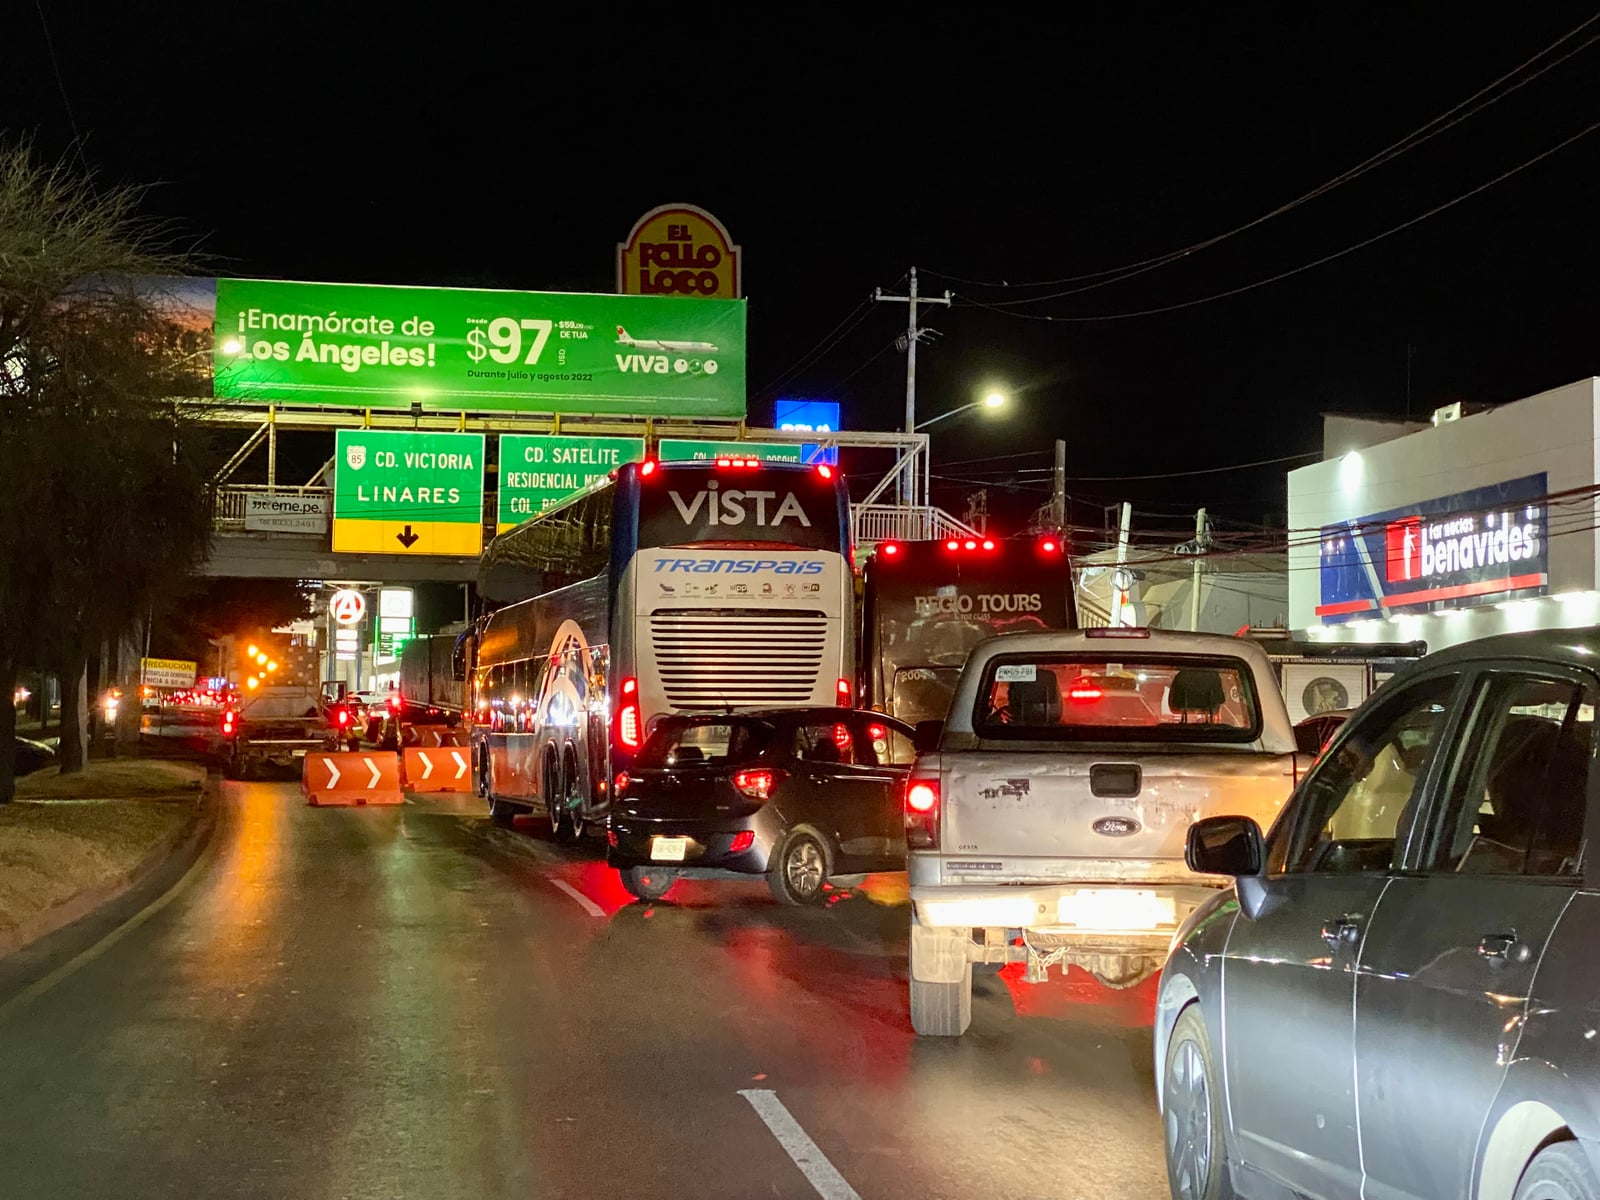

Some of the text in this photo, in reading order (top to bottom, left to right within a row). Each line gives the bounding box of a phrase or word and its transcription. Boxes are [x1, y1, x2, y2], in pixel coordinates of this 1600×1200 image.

[668, 224, 692, 241] EL
[639, 243, 721, 269] POLLO
[640, 270, 719, 295] LOCO
[238, 309, 435, 337] ¡Enamórate de
[466, 317, 552, 365] $97
[560, 331, 588, 339] DE TUA
[239, 331, 435, 373] Los Ángeles!
[558, 349, 566, 365] USD
[467, 370, 593, 382] Durante julio y agosto 2022
[351, 454, 363, 464] 85
[375, 451, 473, 470] CD. VICTORIA
[524, 447, 620, 465] CD. SATELITE
[507, 472, 579, 489] RESIDENCIAL
[357, 485, 460, 504] LINARES
[510, 497, 537, 514] COL.
[1421, 510, 1534, 577] benavides
[977, 594, 1042, 612] TOURS
[1103, 820, 1128, 832] Ford
